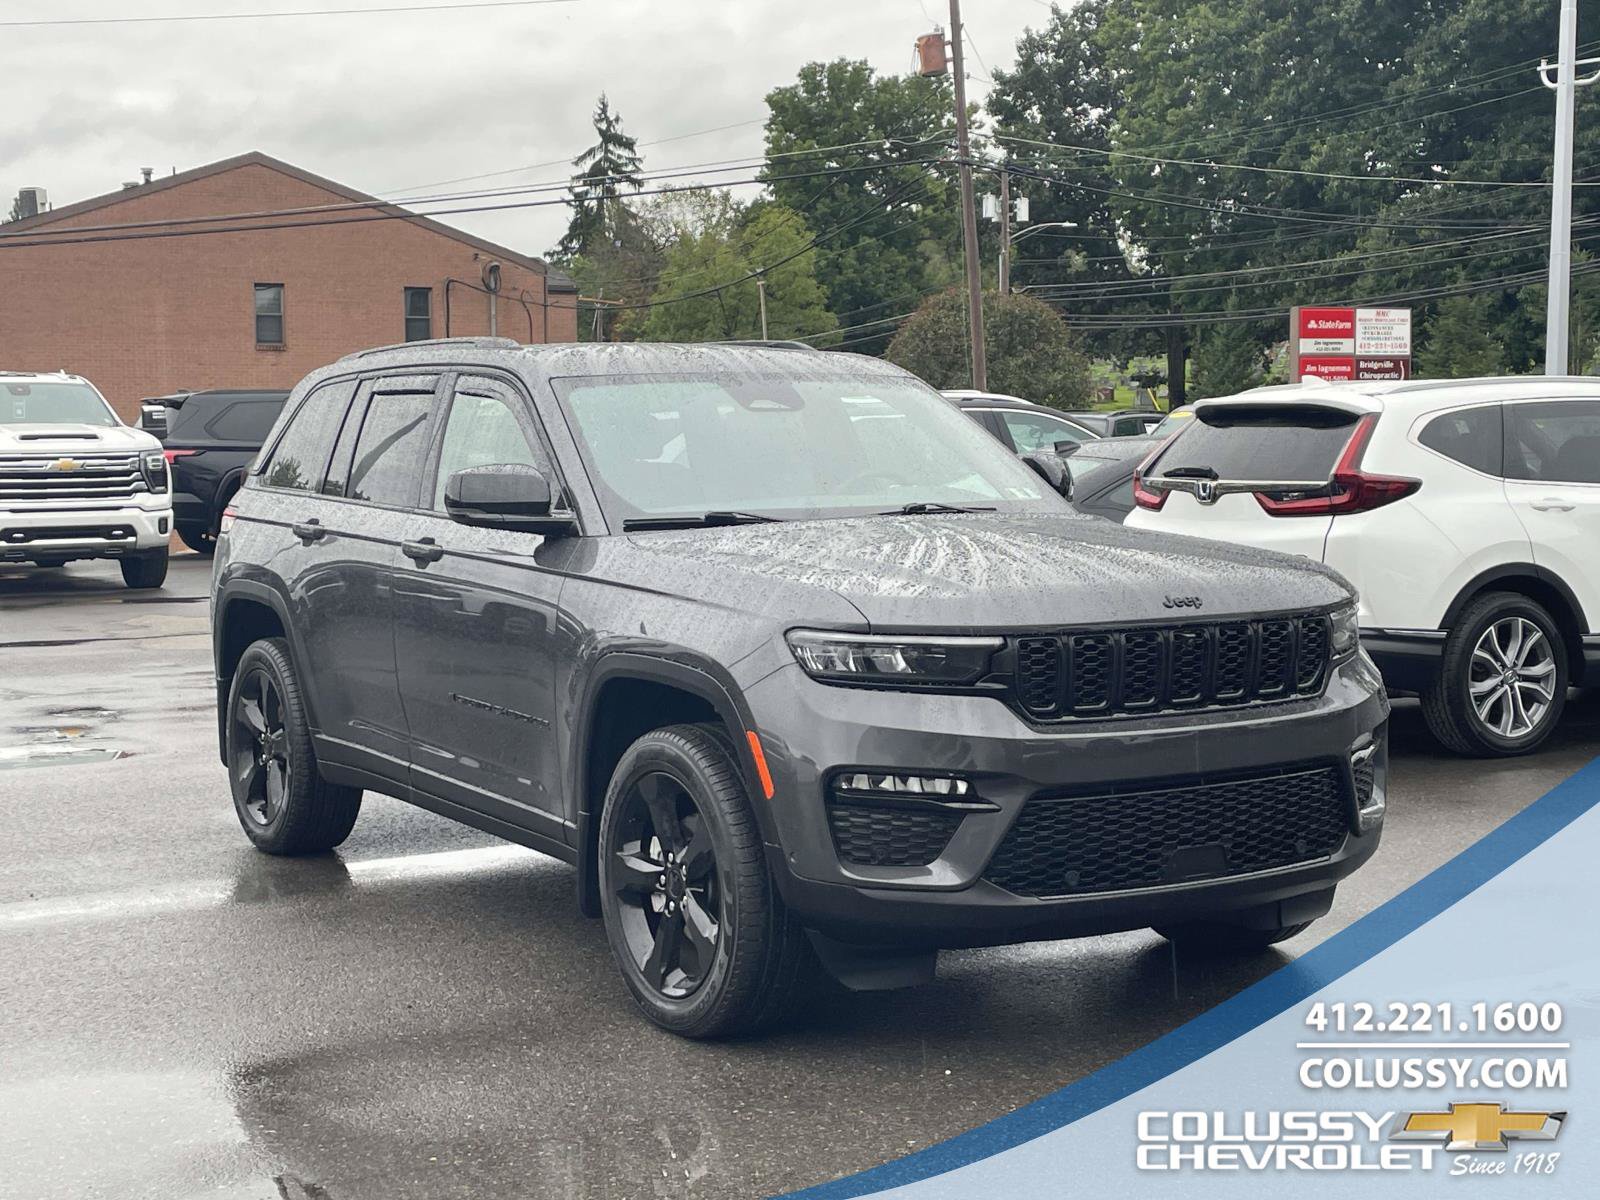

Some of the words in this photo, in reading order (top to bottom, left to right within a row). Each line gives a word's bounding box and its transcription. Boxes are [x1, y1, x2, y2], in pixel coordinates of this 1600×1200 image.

[1305, 364, 1317, 372] Jim
[1360, 360, 1395, 370] Bridgeville
[1360, 371, 1400, 381] Chiropractic
[1162, 595, 1204, 610] Jeep
